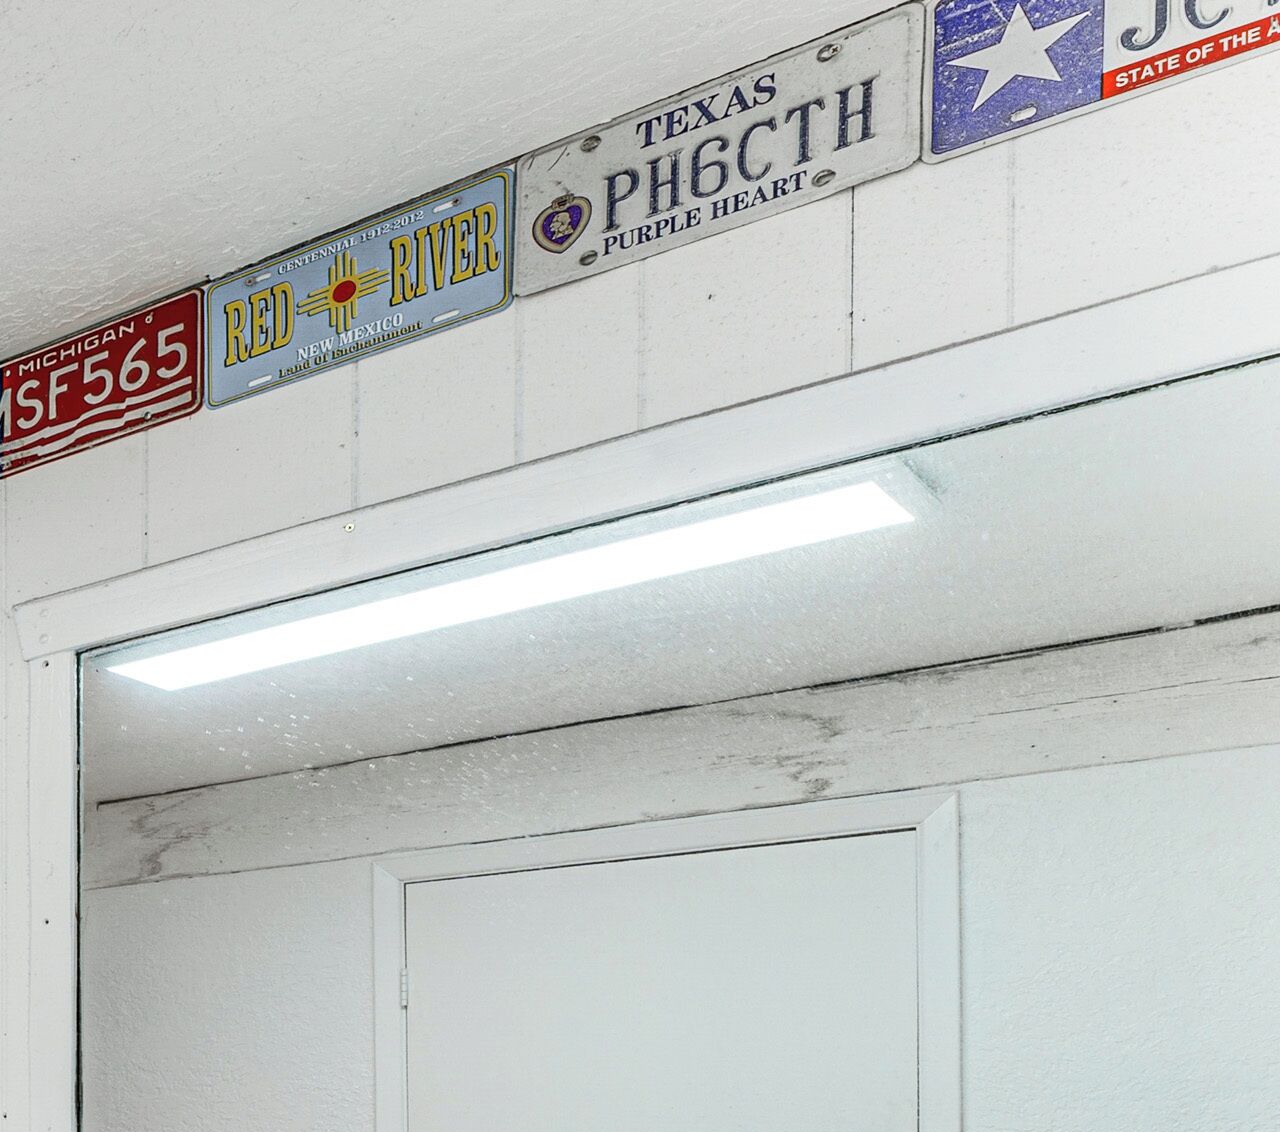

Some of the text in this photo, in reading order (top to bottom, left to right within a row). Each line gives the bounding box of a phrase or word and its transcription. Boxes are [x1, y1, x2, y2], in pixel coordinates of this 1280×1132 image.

[1115, 54, 1181, 88] STATE
[1185, 43, 1215, 64] OF
[1219, 26, 1262, 52] THE
[636, 72, 777, 150] TEXAS
[602, 71, 881, 235] PH6CTH
[277, 210, 425, 275] CENTENNIAL 1912-2012
[602, 170, 808, 257] PURPLE HEART
[224, 202, 501, 368] RED RIVER
[18, 321, 135, 377] MICHIGAN
[296, 312, 404, 362] NEW MEXICO
